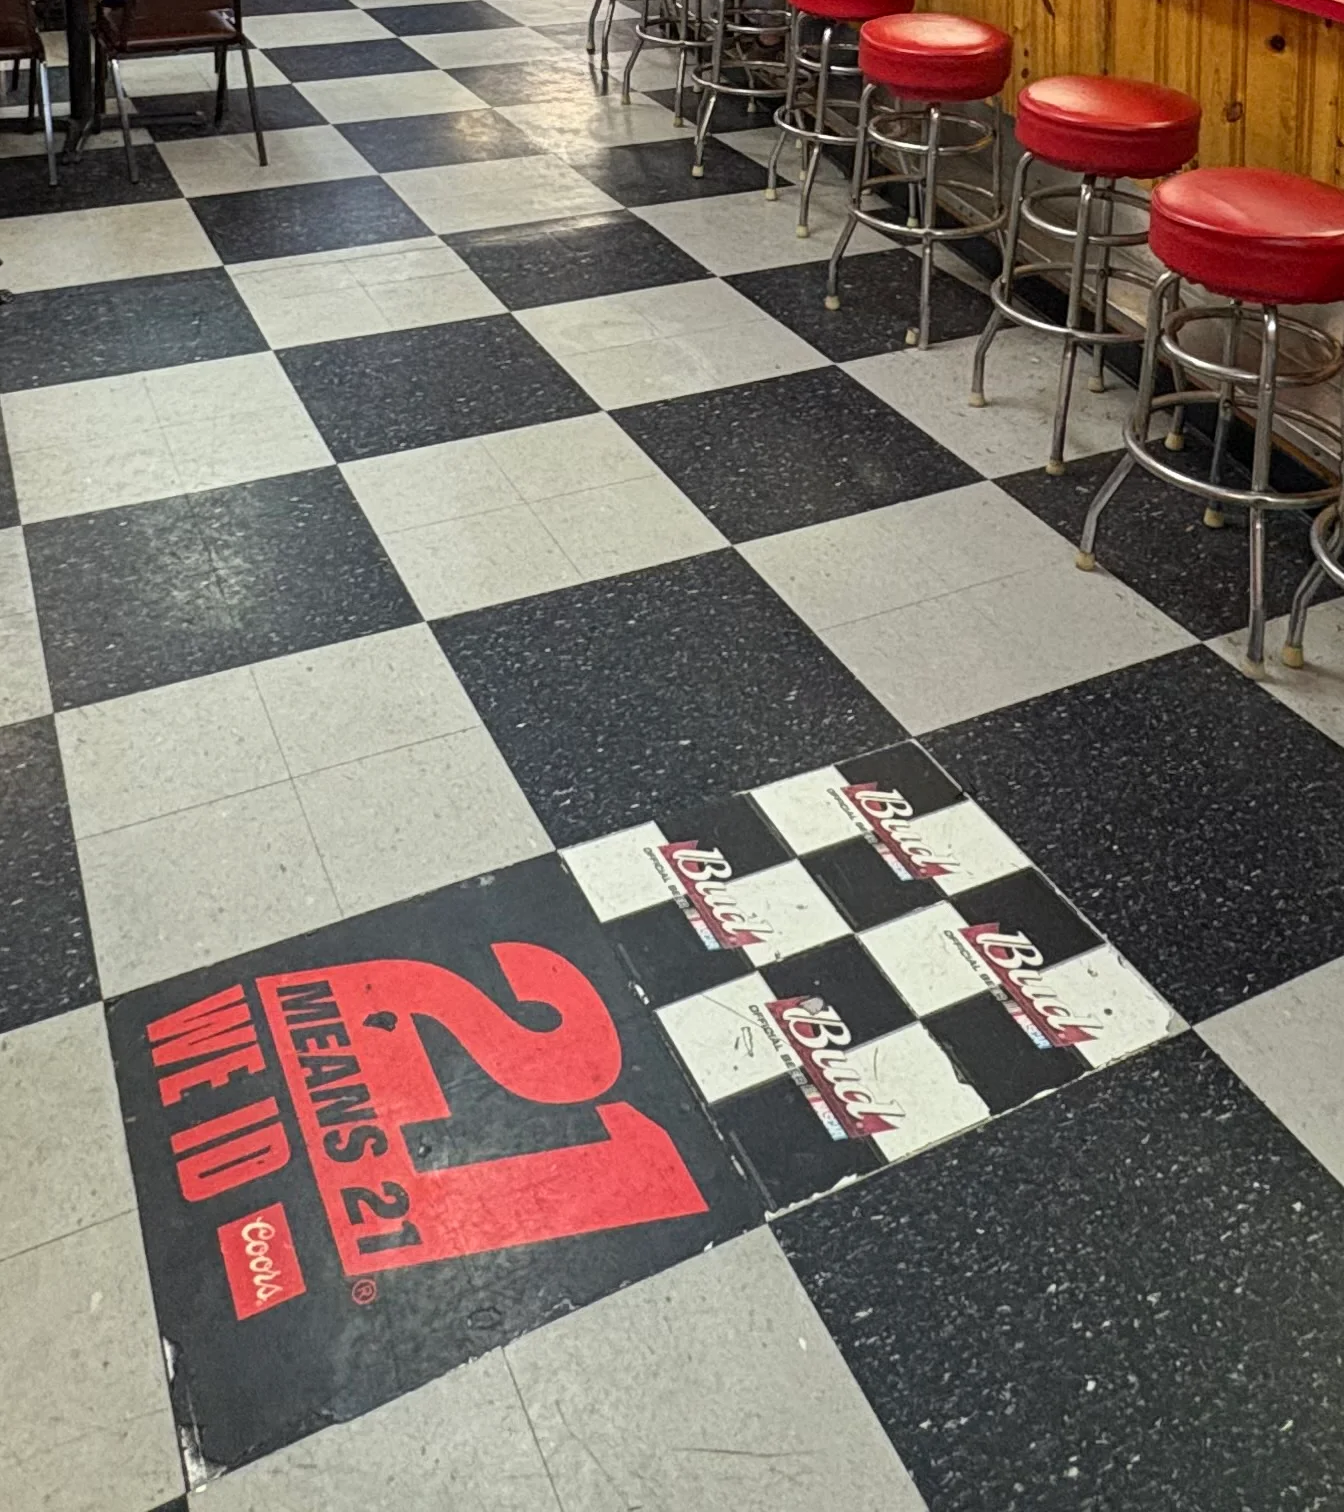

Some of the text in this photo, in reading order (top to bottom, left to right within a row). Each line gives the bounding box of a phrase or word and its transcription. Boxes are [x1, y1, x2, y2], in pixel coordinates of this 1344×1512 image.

[643, 847, 671, 883] OFFICIAL
[855, 788, 961, 868] Bud
[672, 846, 775, 937] Bud
[943, 929, 981, 972] OFFICIAL
[976, 930, 1105, 1031] Bud
[748, 1004, 808, 1085] OFFICIAL BEER
[782, 1004, 906, 1120] Bud
[147, 984, 291, 1203] WE ID
[256, 941, 709, 1276] 21
[277, 979, 423, 1255] MEANS 21
[241, 1215, 284, 1304] Coors
